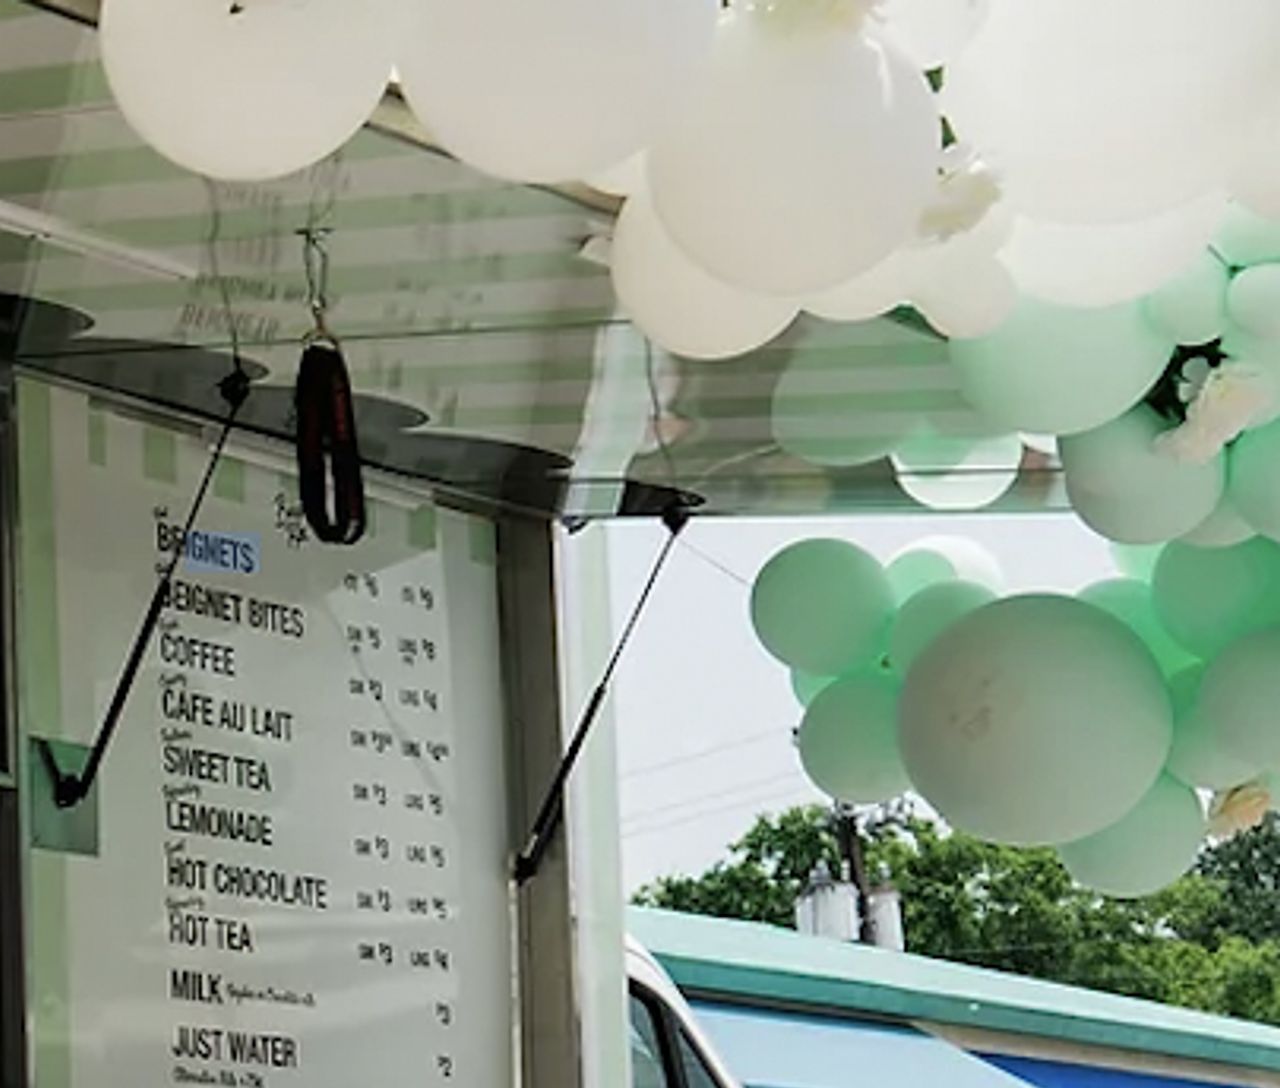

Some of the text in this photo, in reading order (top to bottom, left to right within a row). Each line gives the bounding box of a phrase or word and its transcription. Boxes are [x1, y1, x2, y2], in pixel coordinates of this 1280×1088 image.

[248, 598, 304, 638] BITES
[160, 632, 235, 677] COFFEE
[163, 688, 213, 726] CAFE
[220, 701, 245, 732] AU
[251, 706, 293, 741] LAIT
[163, 746, 230, 783] SWEET
[233, 756, 272, 792] TEA
[167, 801, 273, 846] LEMONADE
[167, 856, 208, 890] HOT
[213, 863, 328, 909] CHOCOLATE
[169, 910, 209, 947] HOT
[214, 917, 254, 952] TEA
[171, 969, 224, 1005] MILK
[171, 1025, 223, 1061] JUST
[227, 1031, 298, 1068] WATER
